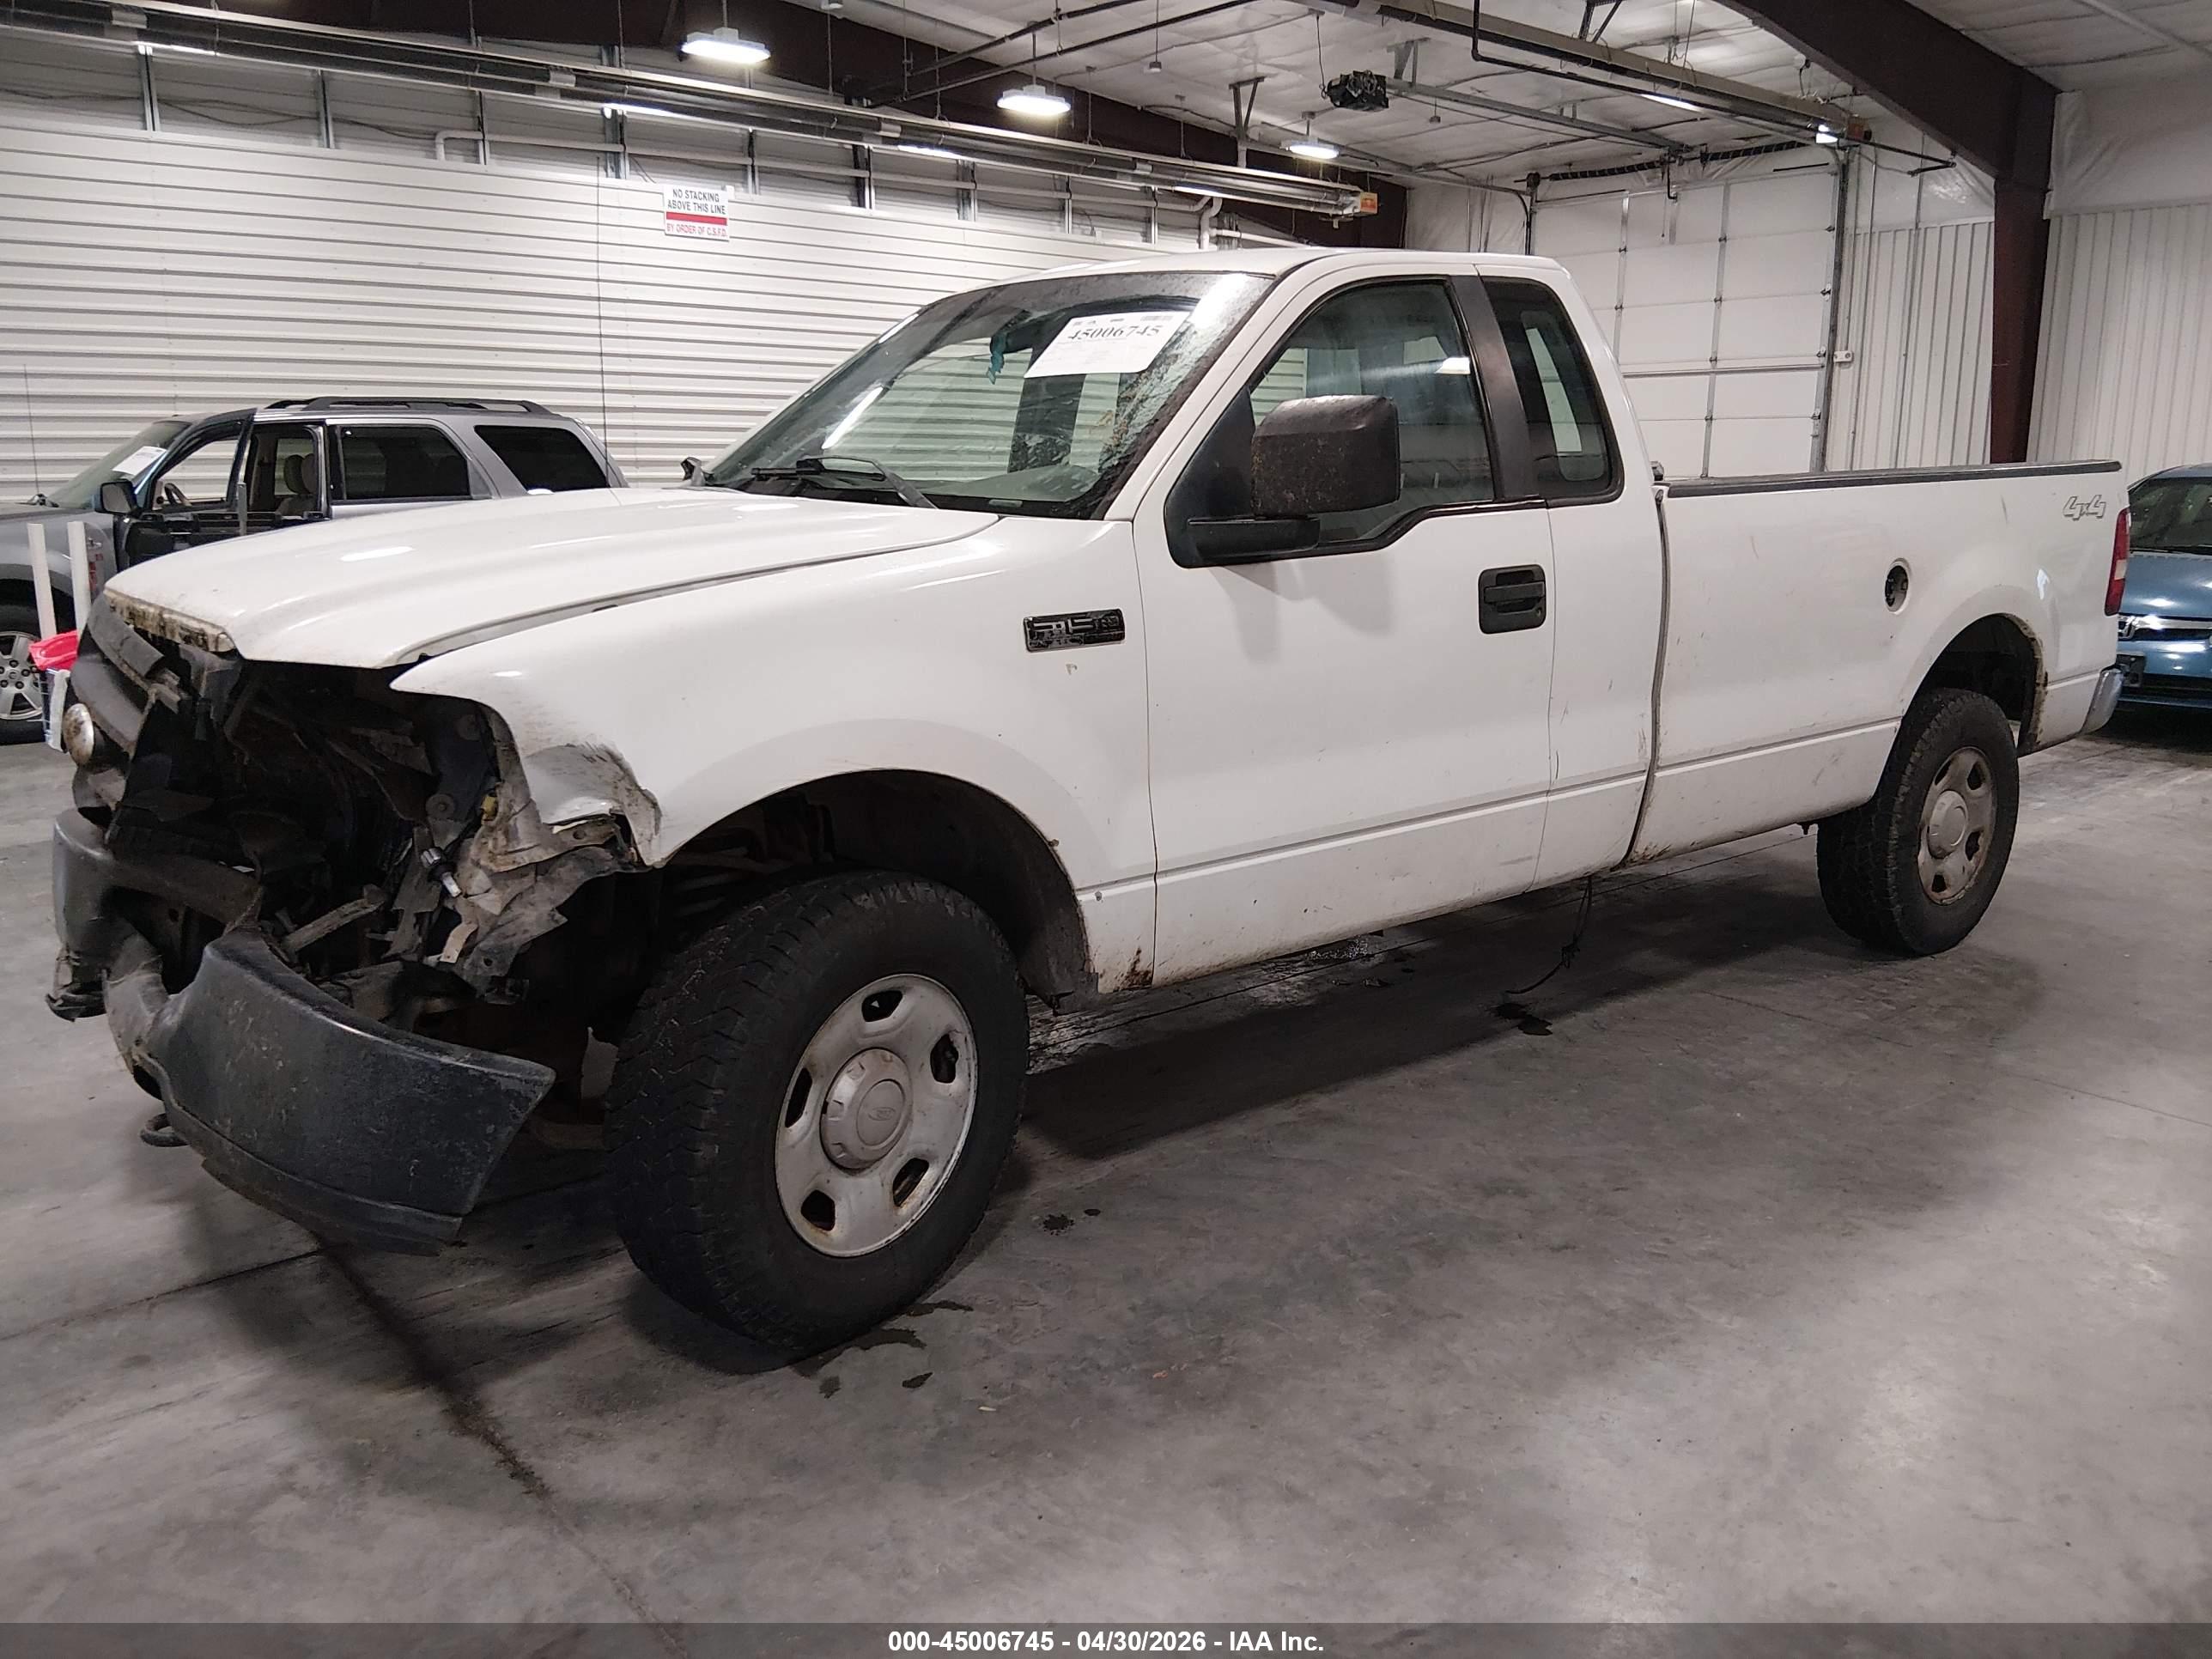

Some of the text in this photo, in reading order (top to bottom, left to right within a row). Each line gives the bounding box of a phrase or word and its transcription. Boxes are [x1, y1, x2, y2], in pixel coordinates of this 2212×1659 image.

[673, 189, 720, 203] NO STACKING
[667, 200, 726, 215] ABOVE THIS LINE
[666, 223, 674, 233] BY
[676, 223, 696, 234] ORDER
[697, 226, 706, 235] OF
[1067, 325, 1164, 340] 45006745
[2063, 494, 2107, 521] 4x4
